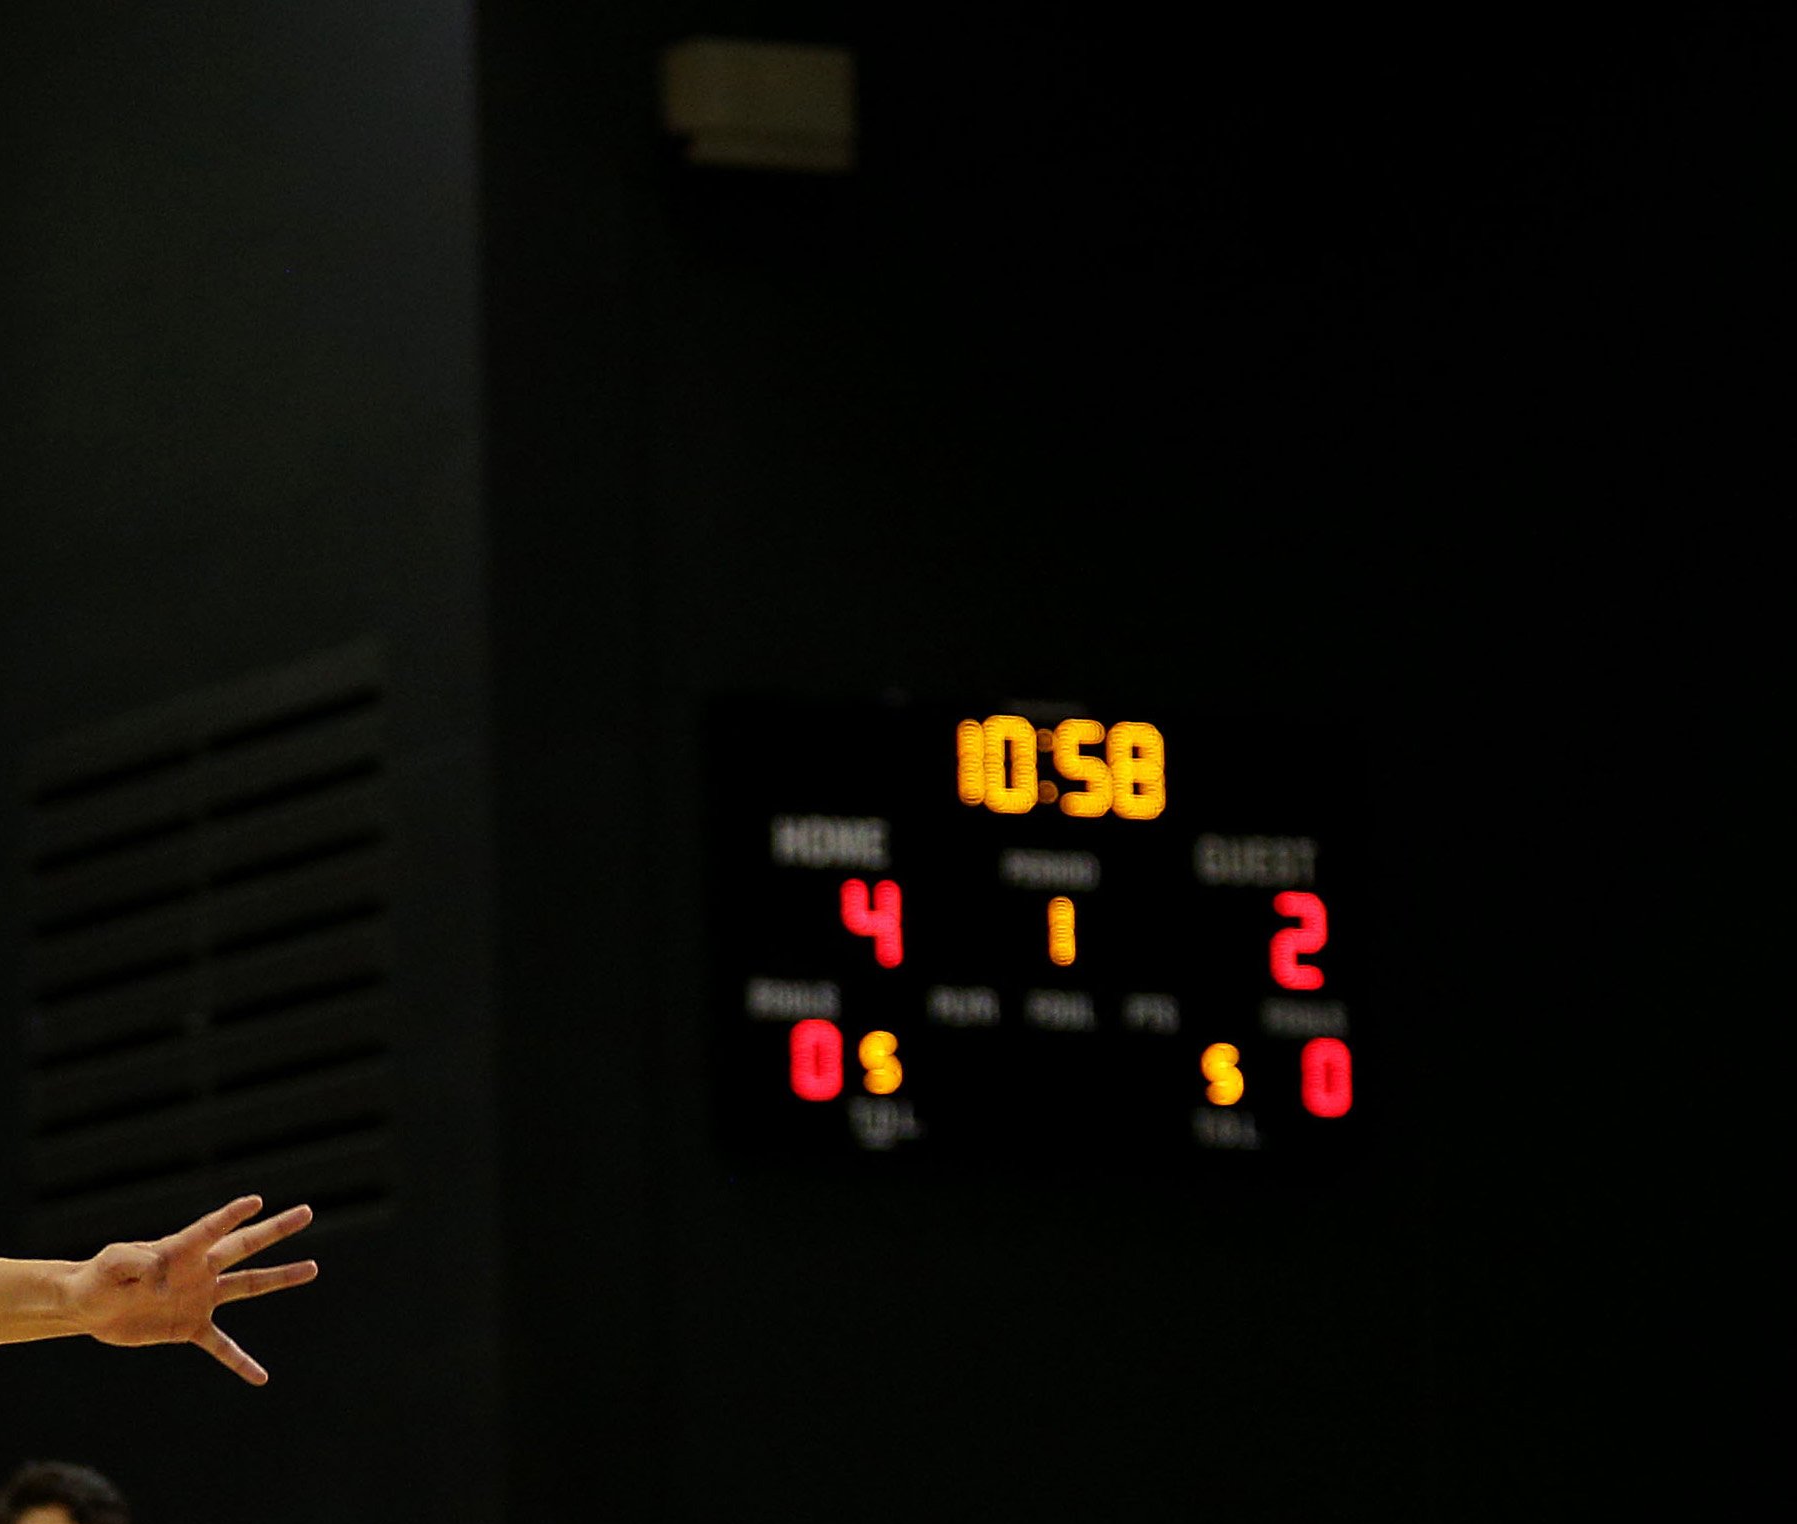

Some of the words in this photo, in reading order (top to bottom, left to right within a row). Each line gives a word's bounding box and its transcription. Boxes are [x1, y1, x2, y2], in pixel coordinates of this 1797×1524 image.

[956, 714, 1166, 820] 10:58
[840, 878, 903, 968] 4
[1047, 896, 1076, 966] 1
[1269, 890, 1328, 990] 2
[789, 1018, 844, 1102] 0
[1301, 1037, 1353, 1118] 0
